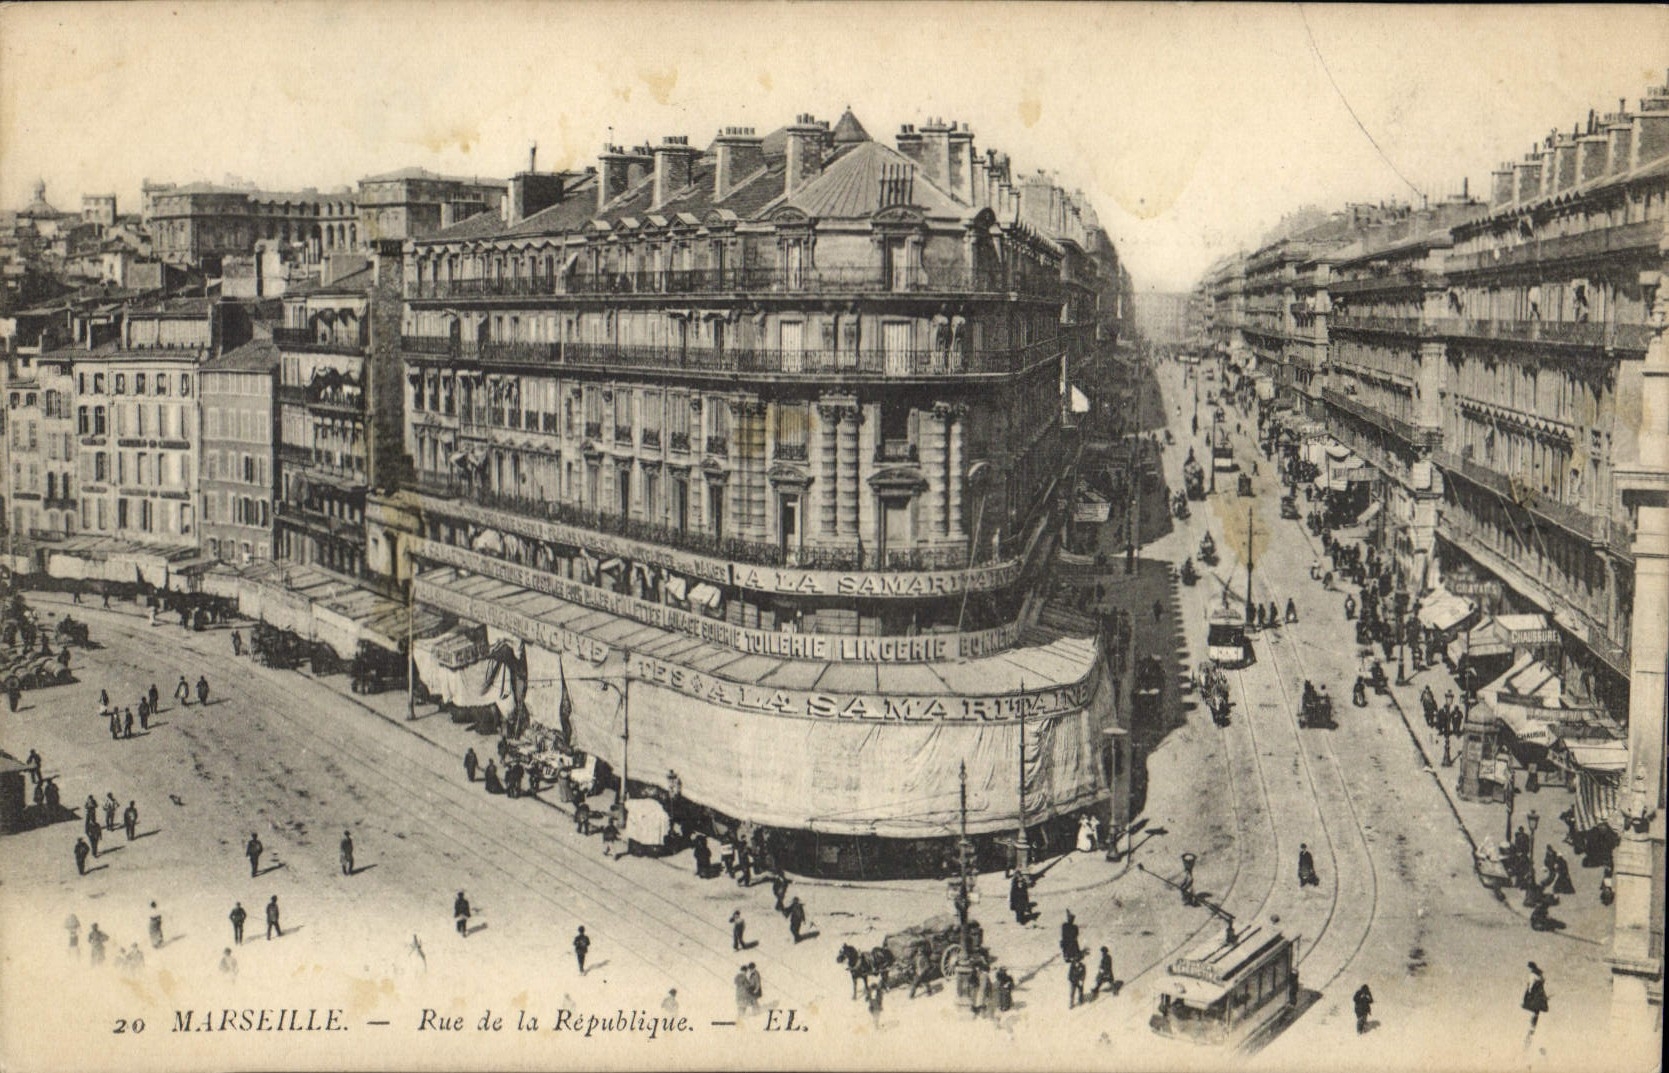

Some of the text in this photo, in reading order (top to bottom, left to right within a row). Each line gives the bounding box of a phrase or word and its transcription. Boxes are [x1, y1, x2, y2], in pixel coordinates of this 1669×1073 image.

[745, 564, 1020, 596] A LA SAMARITAINE
[745, 630, 826, 660] TOILERIE
[840, 637, 947, 662] LINGERIE
[706, 679, 733, 705] A
[737, 686, 799, 714] LA
[804, 683, 1089, 721] SAMARITAINE
